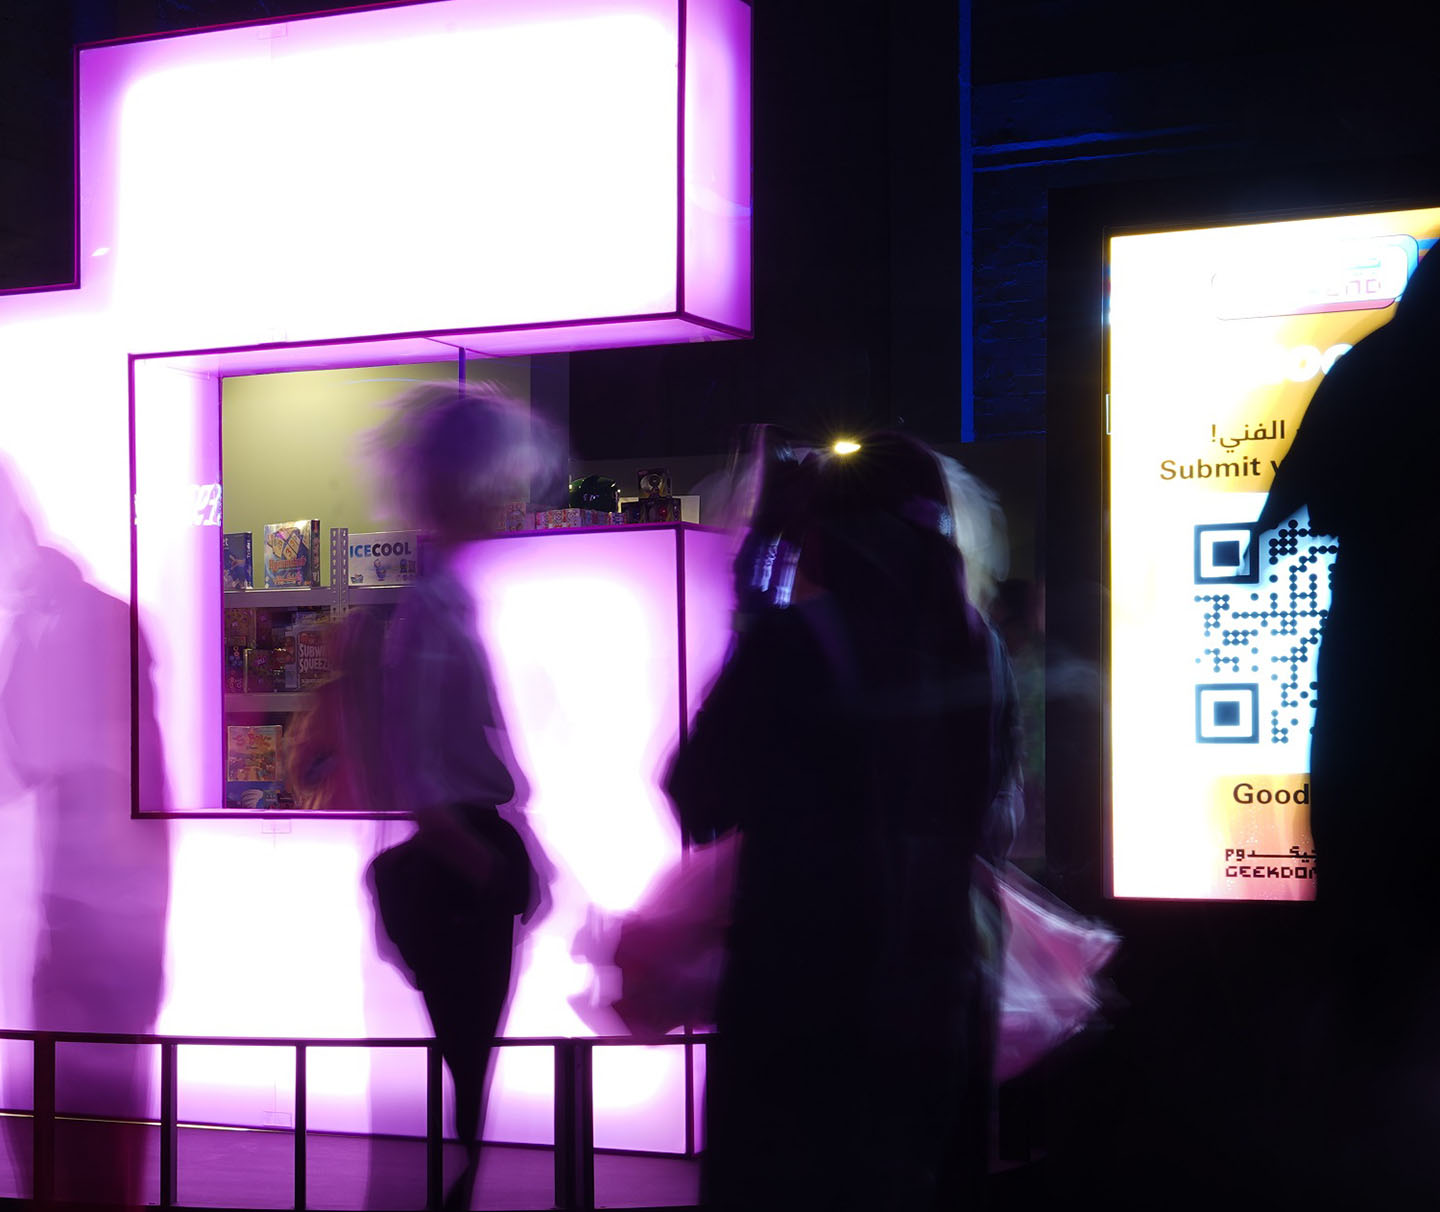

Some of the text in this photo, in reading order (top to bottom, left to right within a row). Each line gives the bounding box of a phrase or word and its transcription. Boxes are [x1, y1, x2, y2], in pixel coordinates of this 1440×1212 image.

[1160, 456, 1261, 481] Submit
[349, 542, 412, 558] ICECOOL
[1232, 783, 1310, 805] Good
